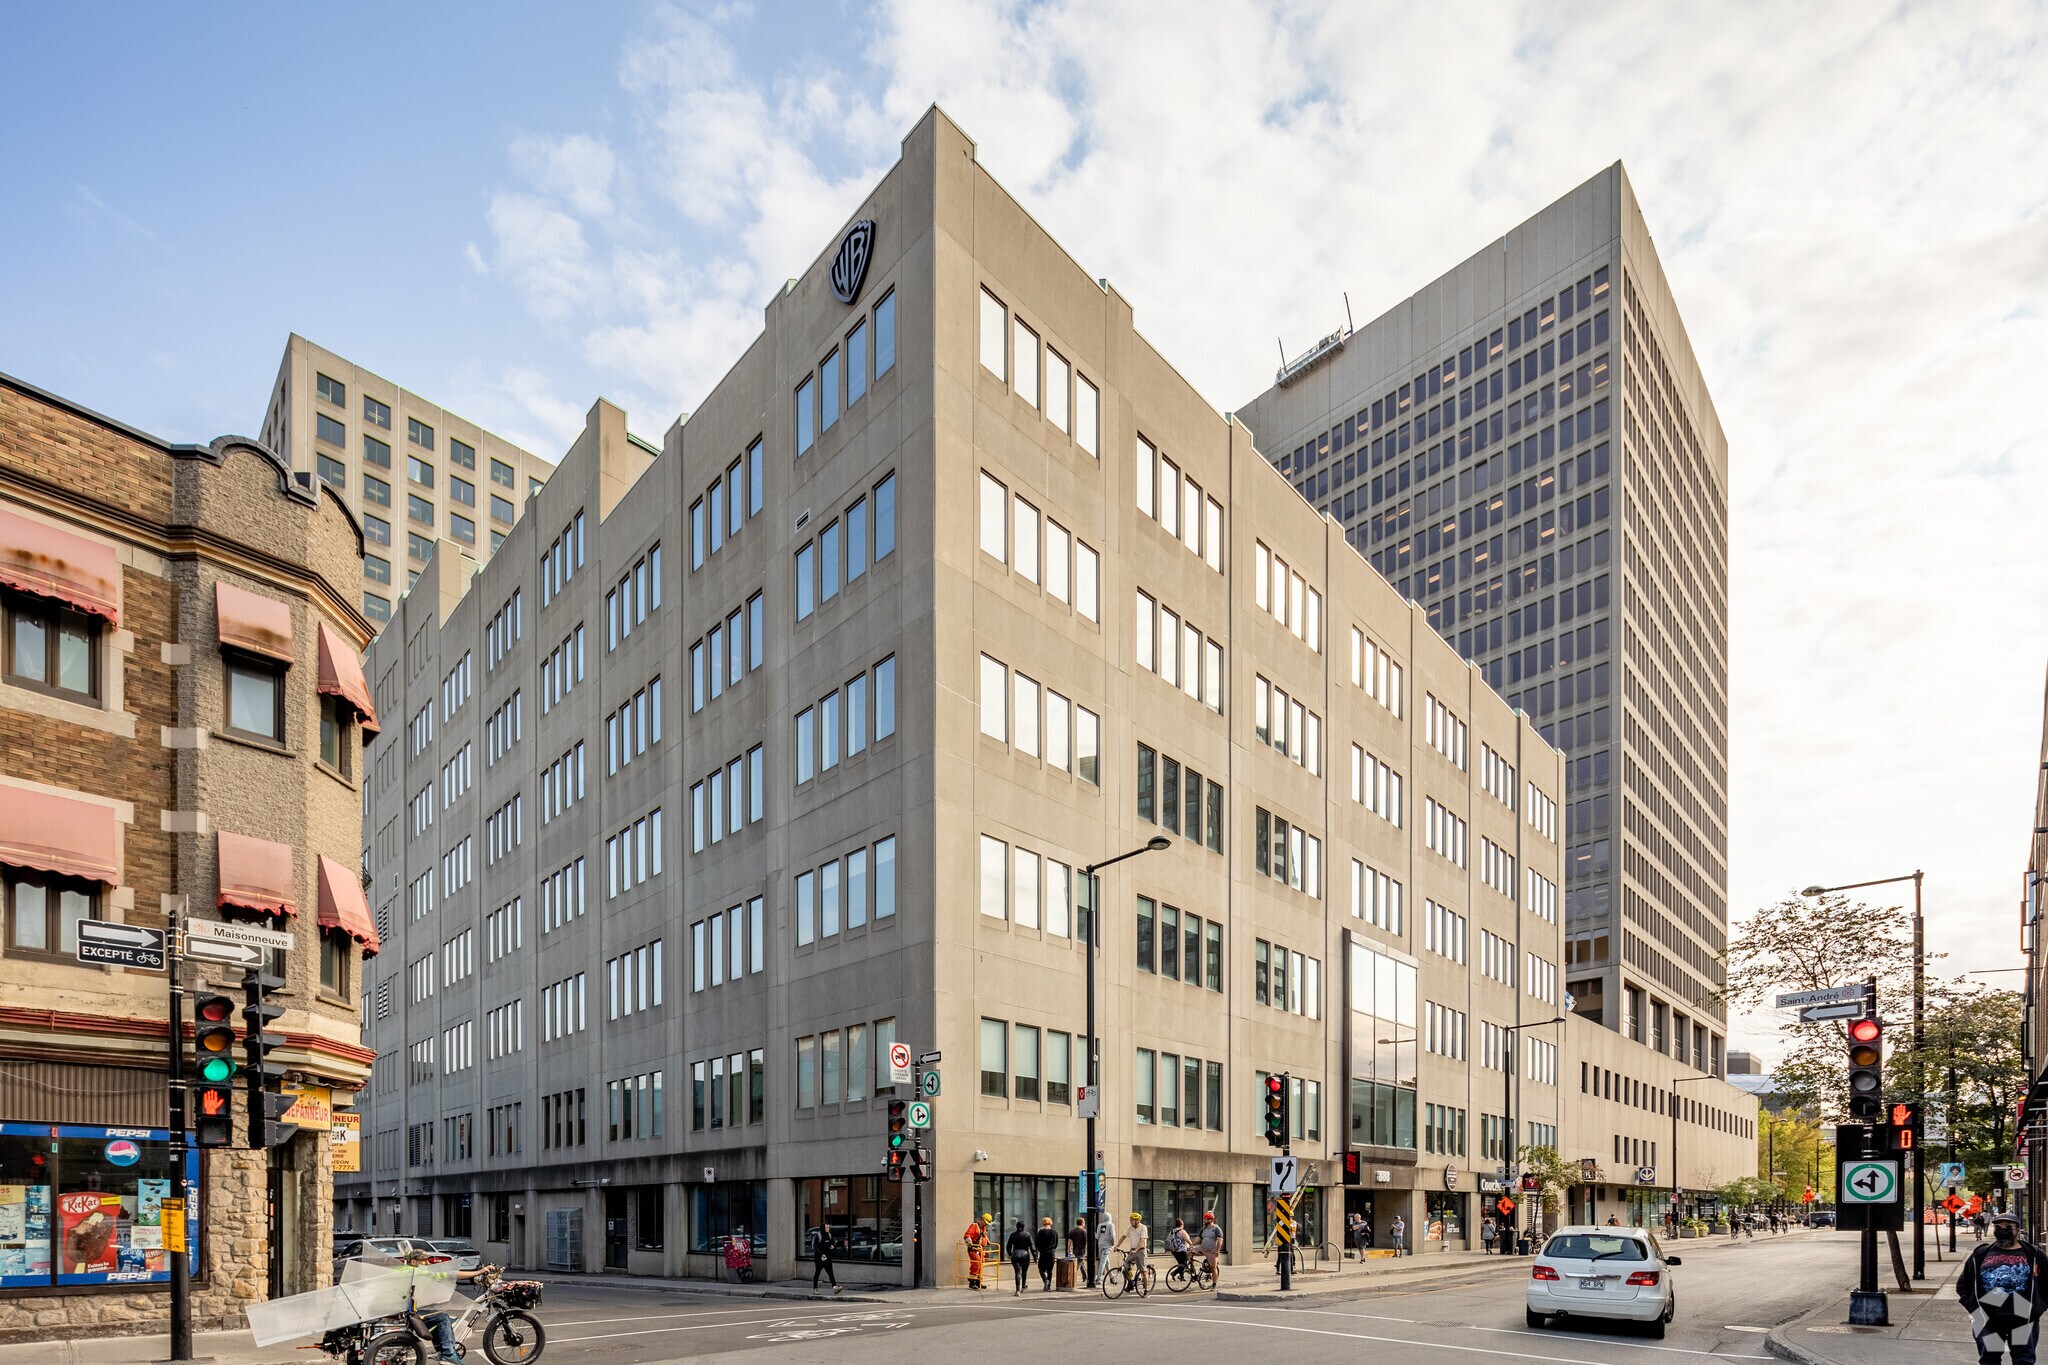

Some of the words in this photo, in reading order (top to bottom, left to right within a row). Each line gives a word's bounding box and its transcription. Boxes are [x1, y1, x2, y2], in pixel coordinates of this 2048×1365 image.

[214, 928, 288, 946] Maisonneuve
[82, 946, 134, 961] EXCEPTÉ
[1780, 991, 1839, 1006] Saint-André
[105, 1128, 150, 1138] PEPSI
[1901, 1130, 1912, 1148] 0
[67, 1196, 97, 1213] KitKat
[188, 1187, 198, 1220] PEPSI
[107, 1272, 152, 1281] PEPSI
